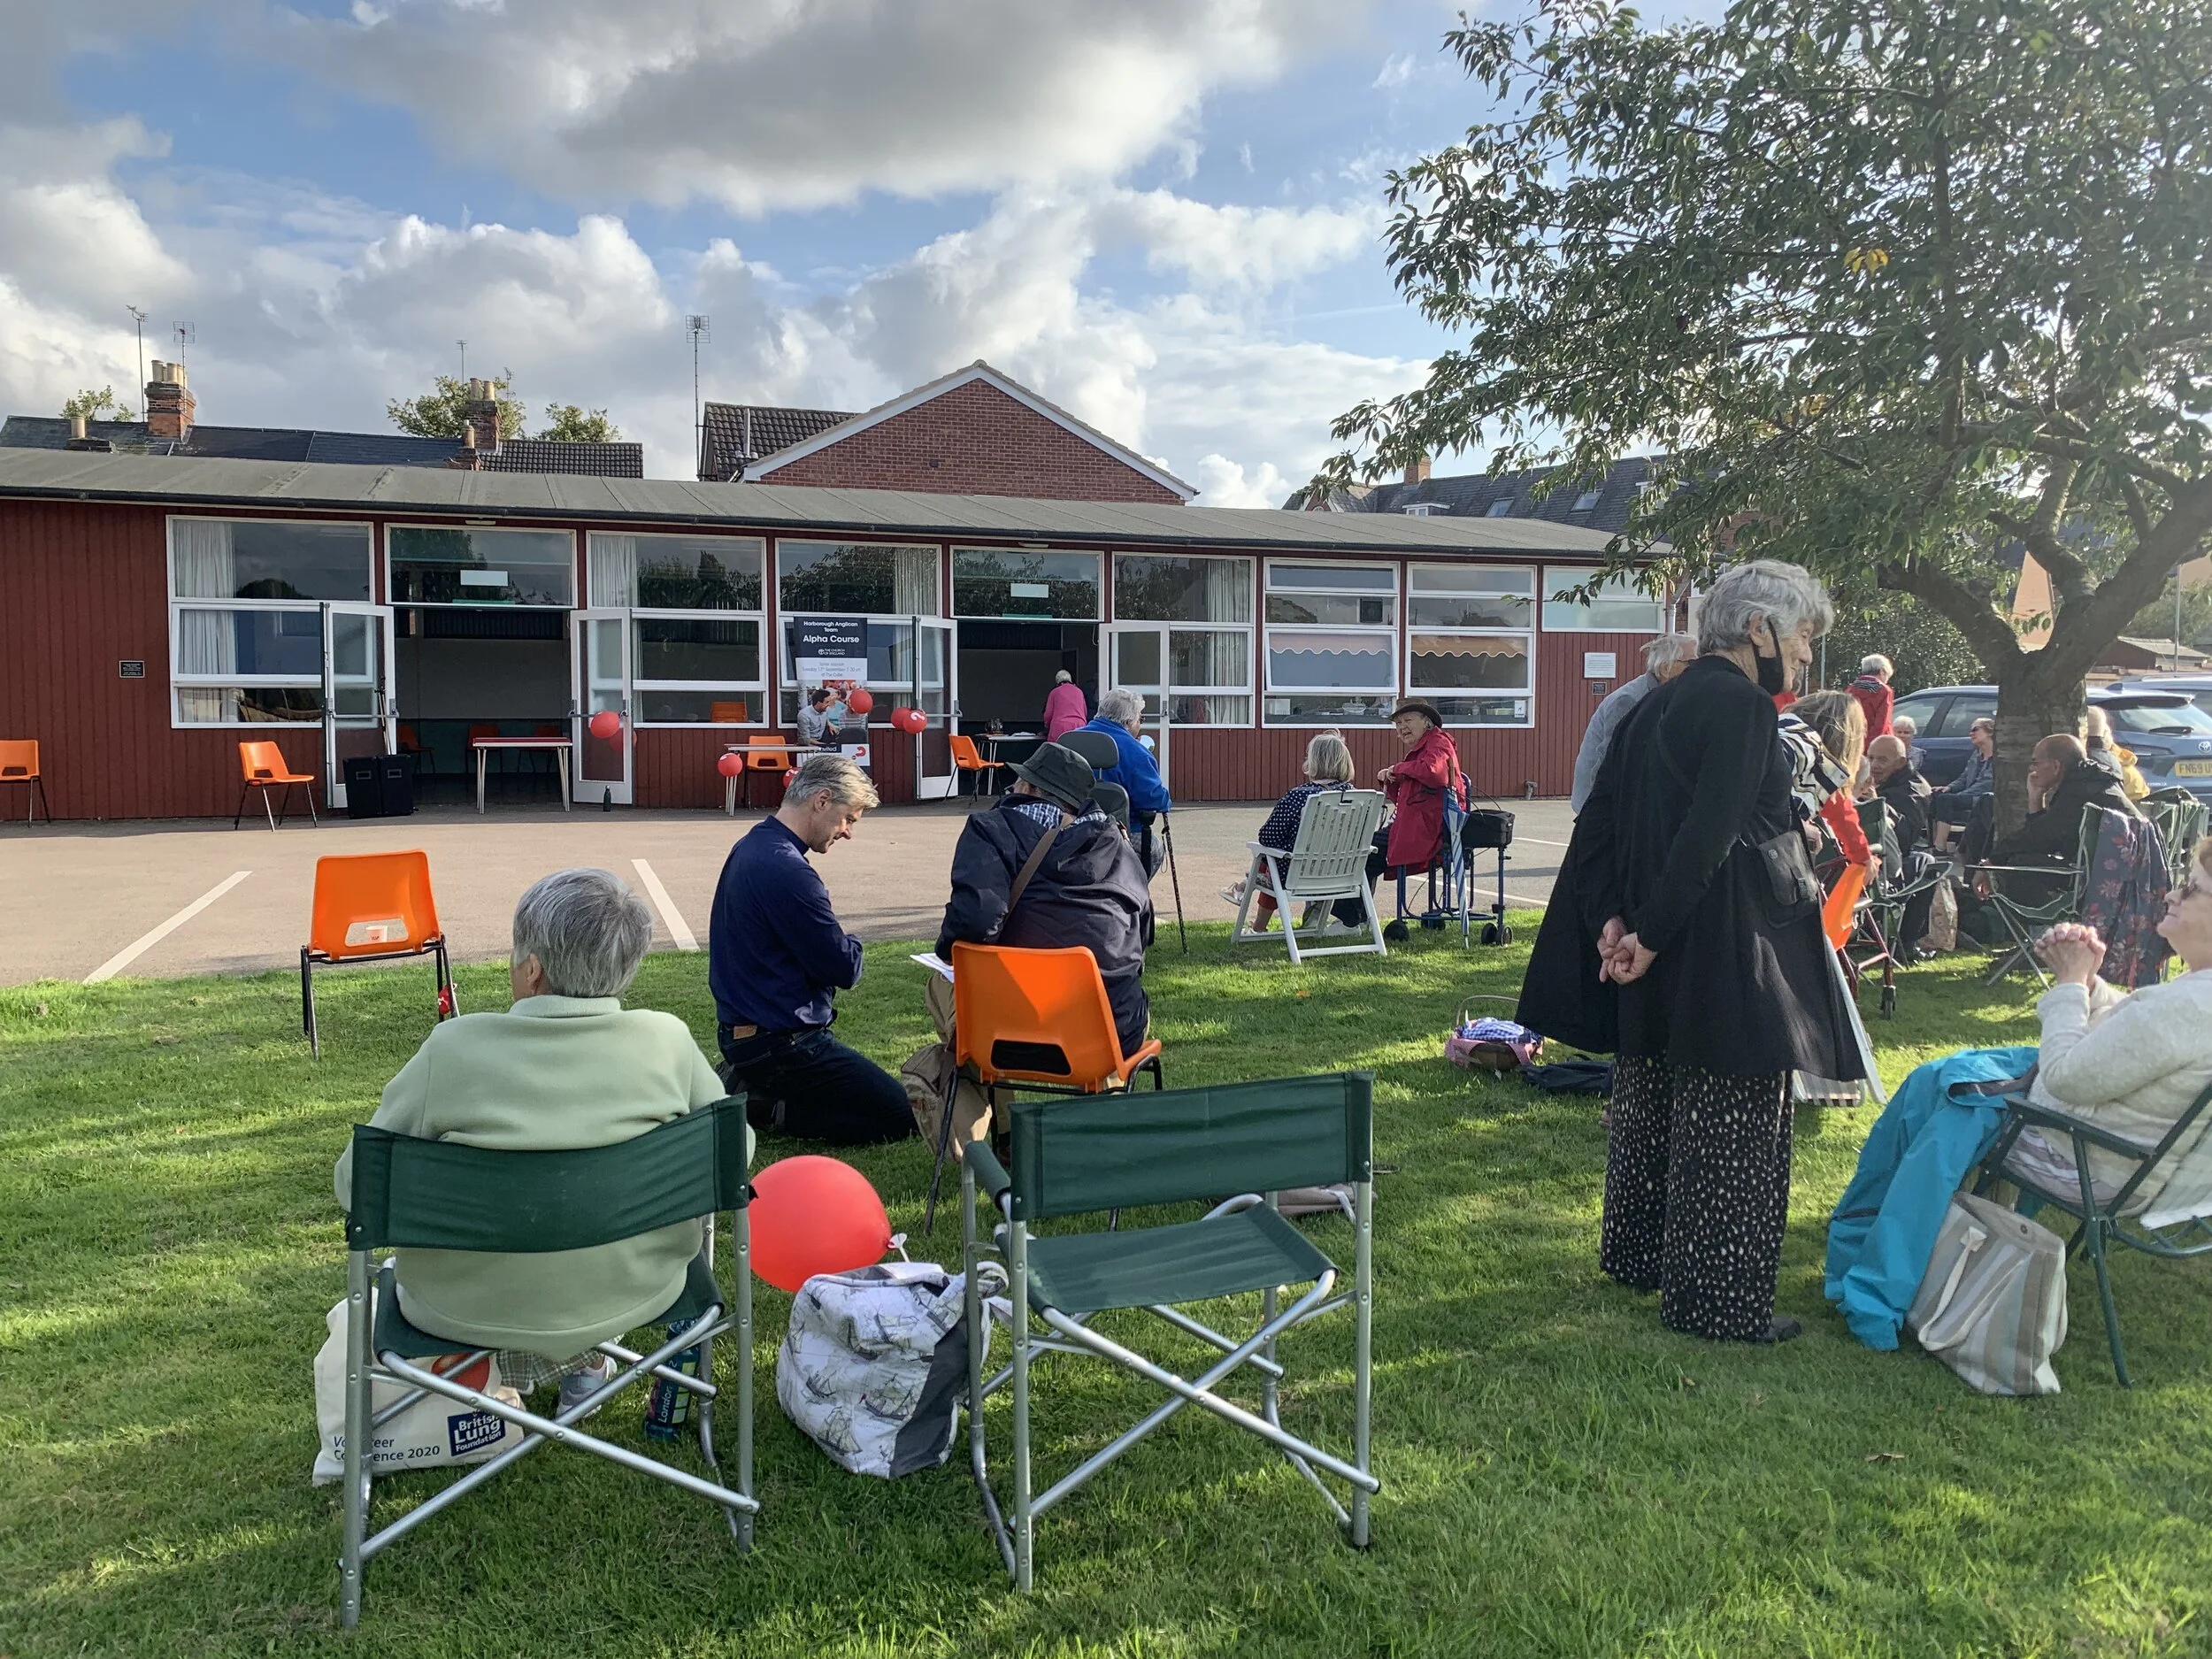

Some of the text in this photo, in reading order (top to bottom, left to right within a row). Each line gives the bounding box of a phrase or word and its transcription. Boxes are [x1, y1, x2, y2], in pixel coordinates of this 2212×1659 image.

[803, 634, 860, 644] Alpha Course
[454, 1419, 501, 1444] Lung
[455, 1430, 502, 1452] Foundation
[407, 1445, 441, 1459] 2020
